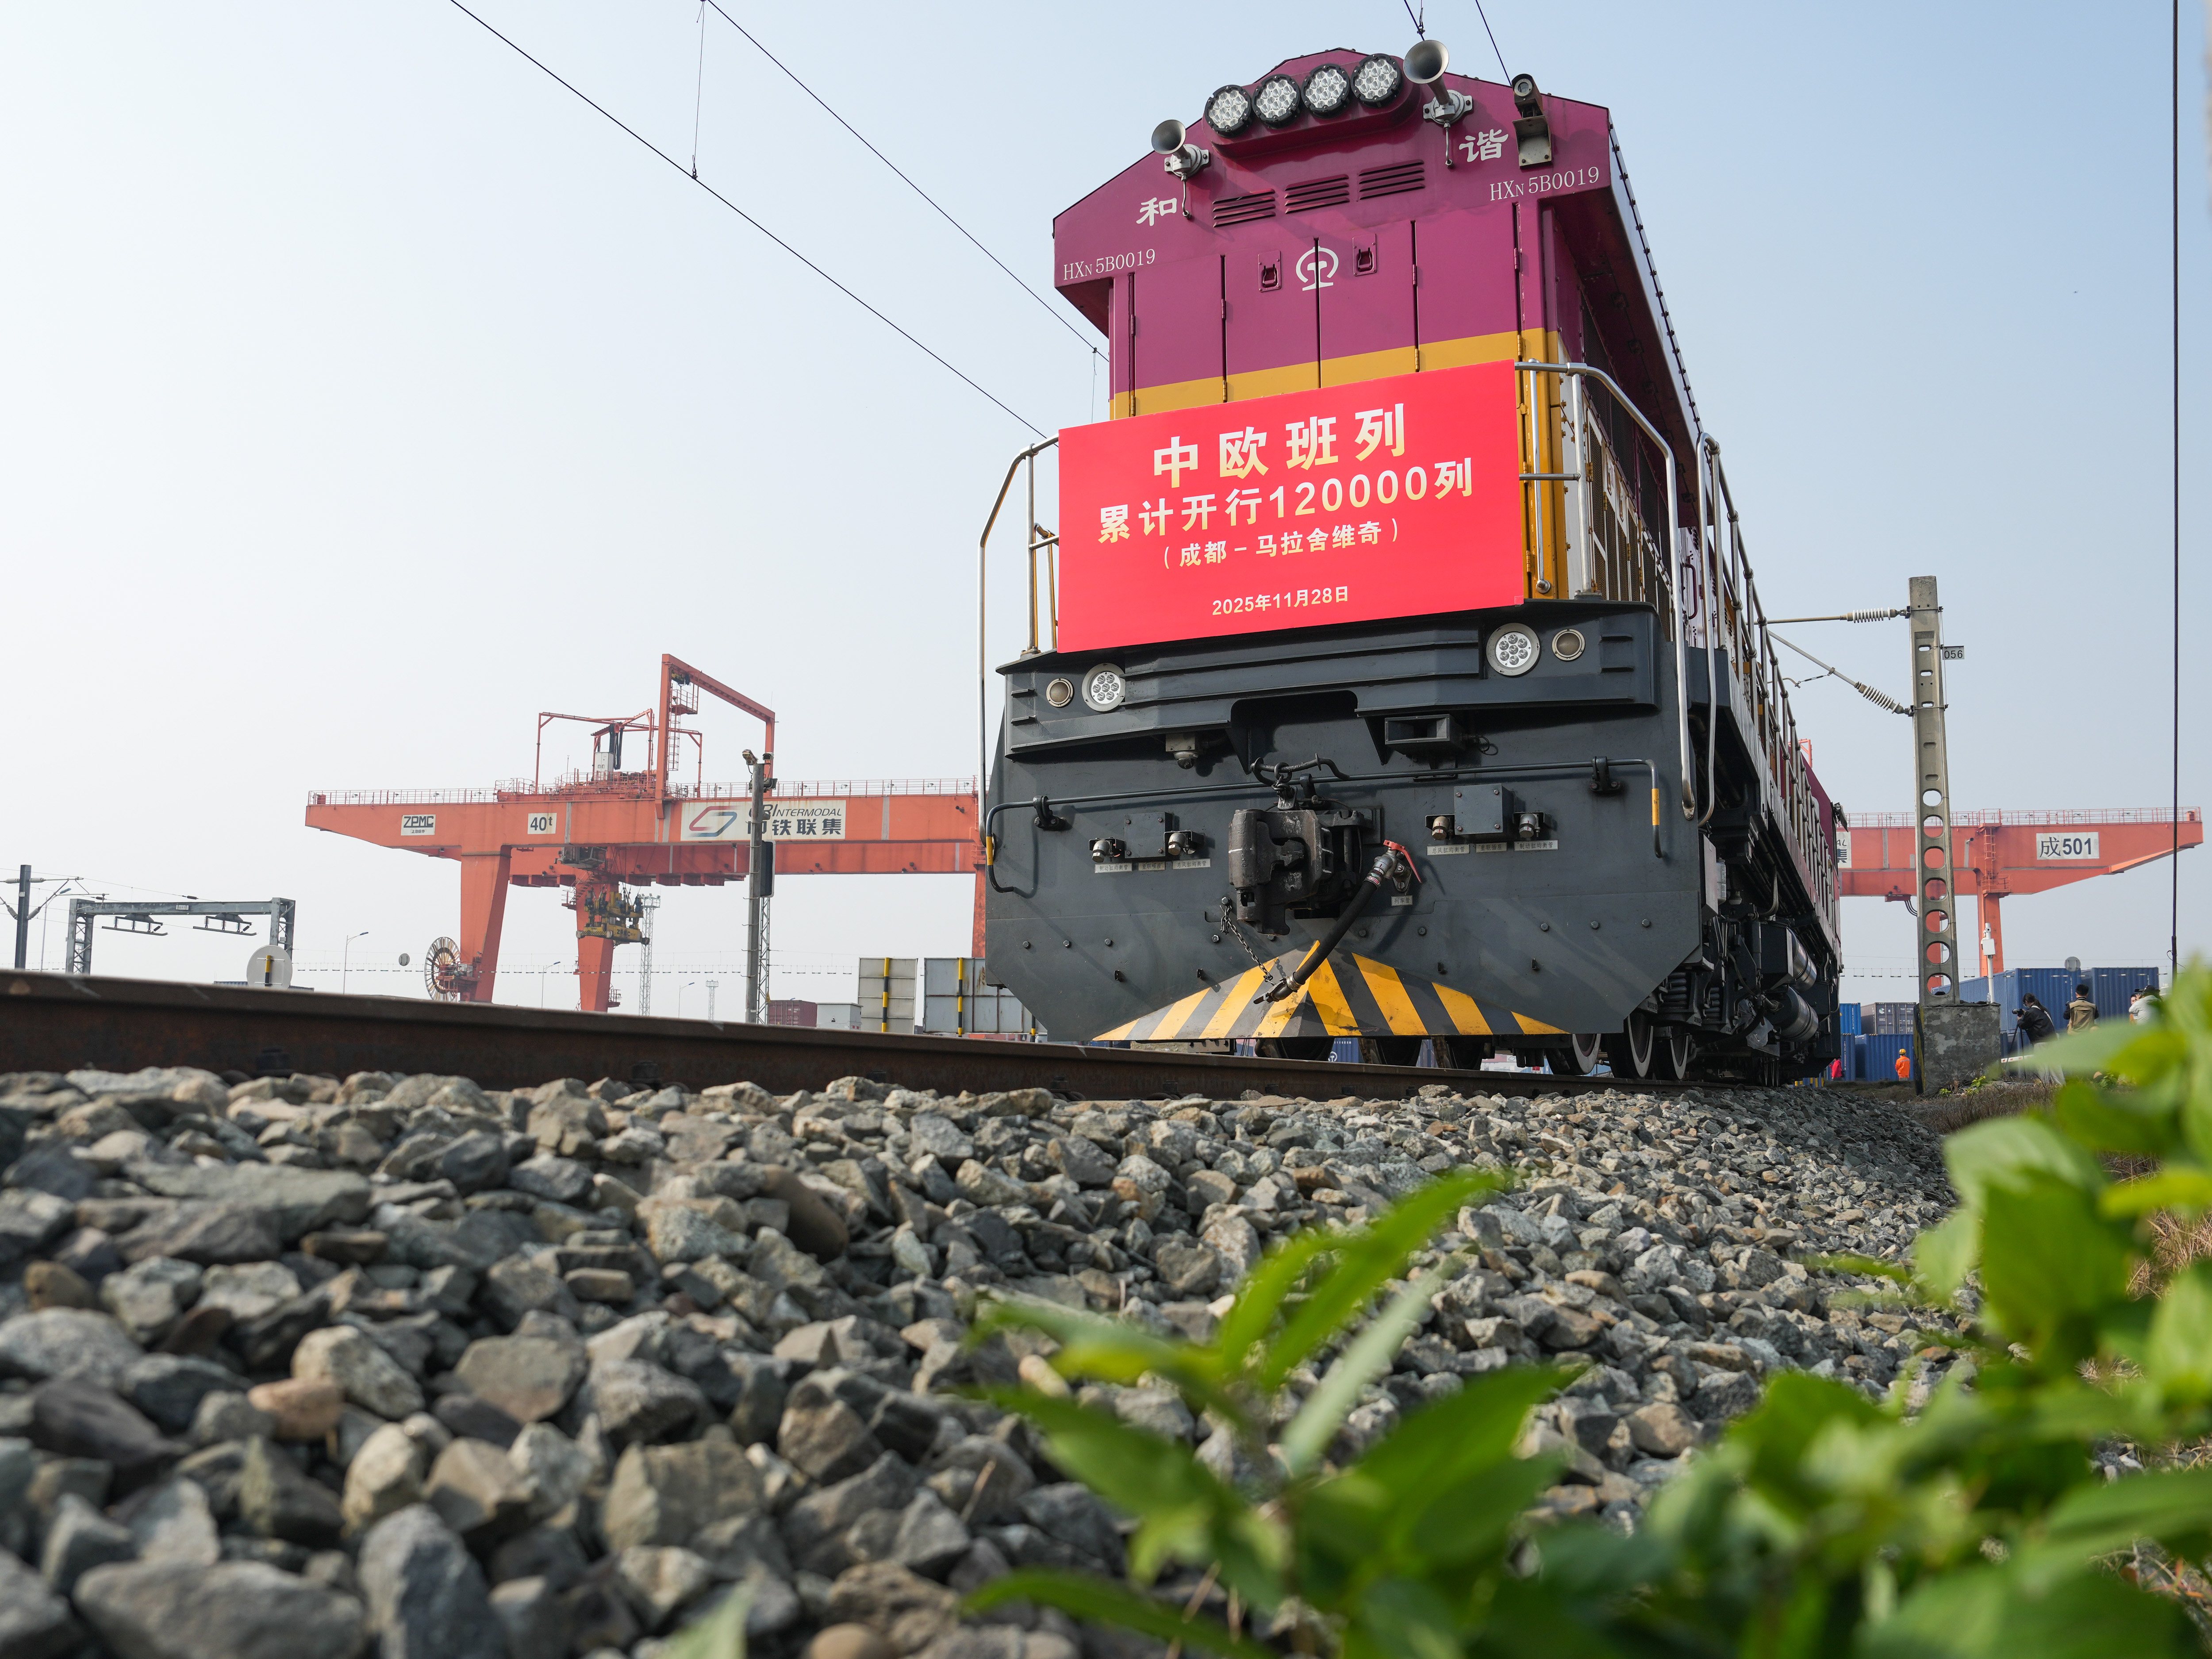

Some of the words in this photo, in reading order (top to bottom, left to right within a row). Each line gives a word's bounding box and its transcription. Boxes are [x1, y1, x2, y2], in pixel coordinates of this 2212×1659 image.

[1459, 129, 1508, 162] 谐
[1136, 197, 1177, 226] 和
[1154, 403, 1405, 488] 中欧班列
[1098, 458, 1471, 543] 累计开行120000列
[1213, 586, 1347, 615] 2025年11月28日
[1944, 650, 1962, 659] 056
[403, 816, 434, 828] ZPMC
[2039, 837, 2091, 857] 成501
